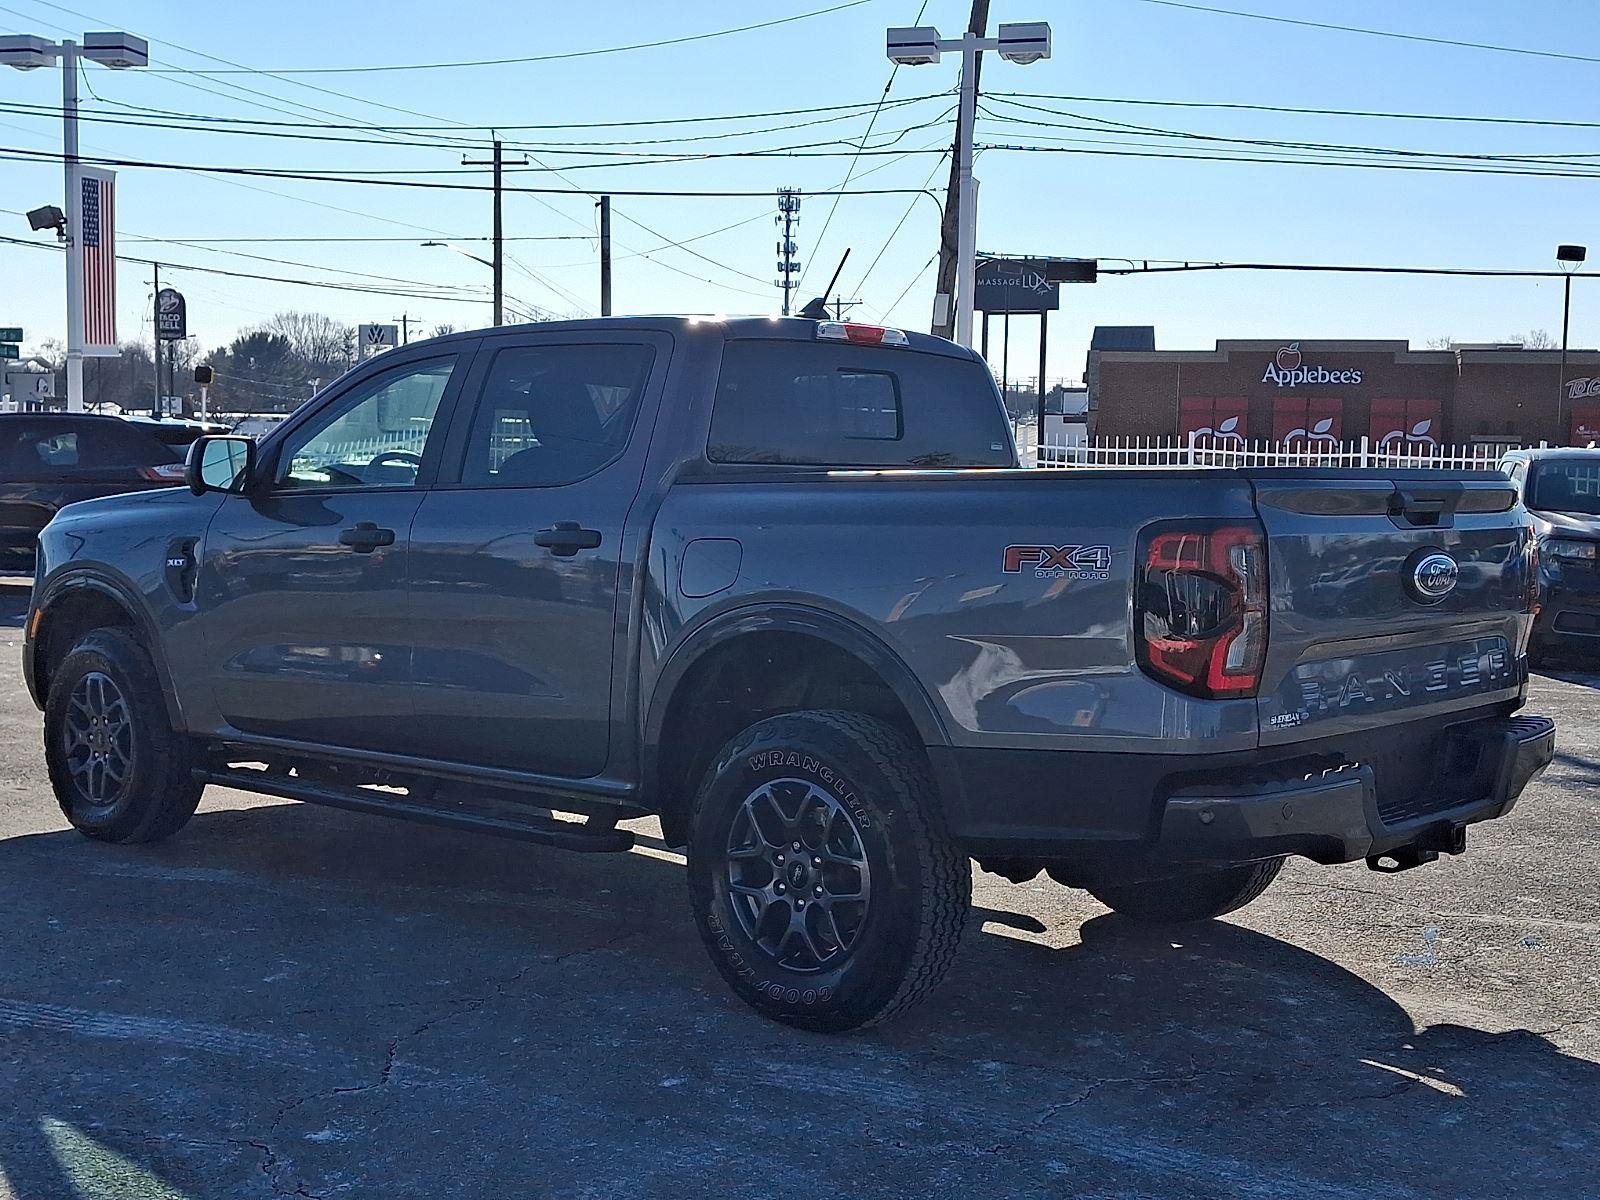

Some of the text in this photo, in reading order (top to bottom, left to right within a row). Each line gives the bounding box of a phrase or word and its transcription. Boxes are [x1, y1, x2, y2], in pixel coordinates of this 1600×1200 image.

[976, 271, 1053, 290] MASSAGE LUX
[159, 313, 181, 322] TACO
[159, 321, 180, 330] BELL
[1261, 361, 1362, 387] Applebee's
[167, 558, 185, 567] XLT
[1002, 544, 1112, 573] FX4
[1034, 570, 1110, 580] OFF ROAD
[1427, 563, 1453, 587] Ford
[1299, 648, 1512, 710] RANGER
[749, 750, 871, 829] WRANGLER
[707, 914, 833, 1004] GOODYEAR
